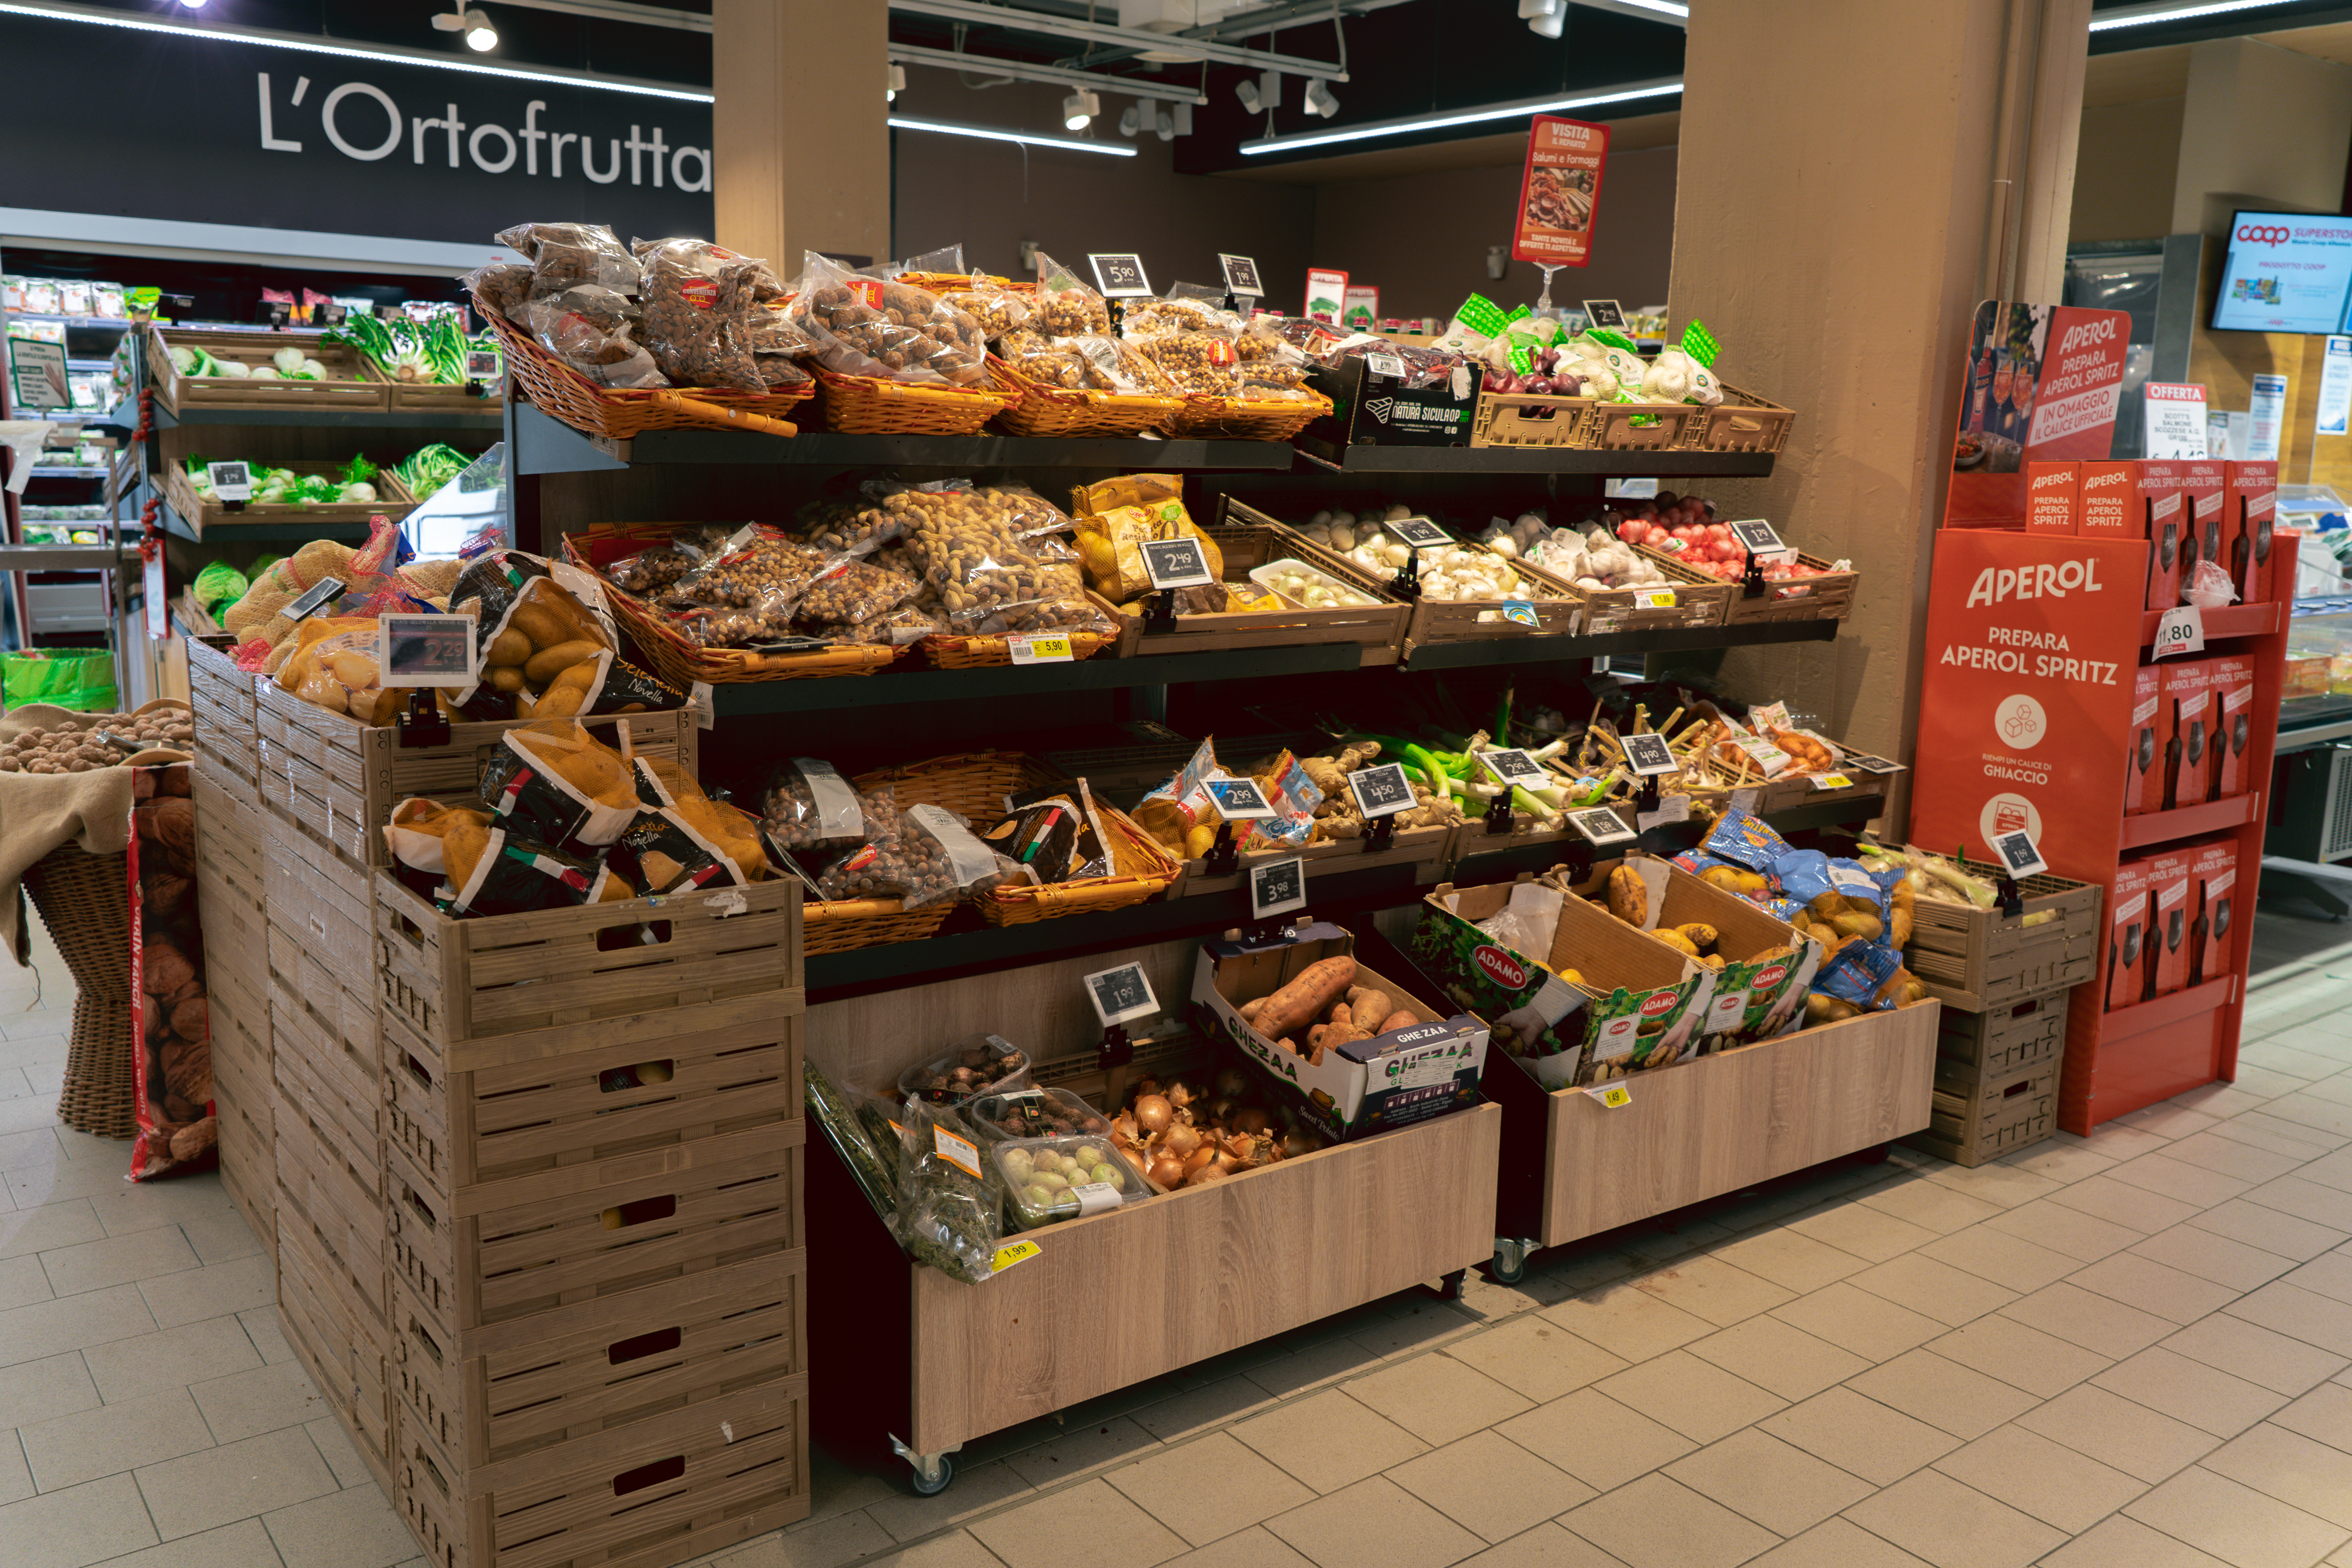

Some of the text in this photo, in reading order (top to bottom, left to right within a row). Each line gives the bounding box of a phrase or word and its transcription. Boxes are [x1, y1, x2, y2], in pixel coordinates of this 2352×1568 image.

[1552, 122, 1590, 141] VISITA
[1552, 138, 1586, 149] IL REPARTO
[1532, 151, 1557, 163] Salumi
[1566, 154, 1600, 168] Formaggi
[1531, 233, 1550, 243] TANTE
[1550, 235, 1572, 245] NOVITÀ
[2237, 225, 2290, 248] coop
[1519, 239, 1586, 255] OFFERTE TI ASPETTANO!
[683, 288, 716, 296] CONVENIENZA
[2059, 316, 2117, 355] APEROL
[2062, 349, 2106, 375] PREPARA
[2043, 362, 2120, 398] APEROL SPRITZ
[2150, 385, 2202, 401] OFFERTA
[1392, 405, 1421, 420] NATURA
[2043, 389, 2110, 423] IN OMAGGIO
[2034, 405, 2113, 441] IL CALICE UFFICIALE
[2149, 467, 2171, 476] PREPARA
[2191, 466, 2214, 476] PREPARA
[2244, 467, 2266, 476] PREPARA
[2032, 471, 2074, 490] APEROL
[2084, 472, 2128, 490] APEROL
[2137, 477, 2181, 489] APEROL SPRITZ
[2181, 476, 2224, 487] APEROL SPRITZ
[2233, 477, 2276, 487] APEROL SPRITZ
[2034, 497, 2070, 505] PREPARA
[2087, 497, 2123, 506] PREPARA
[2034, 506, 2069, 514] APEROL
[2087, 506, 2123, 515] APEROL
[2033, 515, 2069, 525] SPRITZ
[2086, 516, 2123, 526] SPRITZ
[1966, 557, 2102, 609] APEROL
[1989, 627, 2069, 652] PREPARA
[2159, 624, 2193, 644] 11,80
[1046, 641, 1063, 653] 5,90
[1940, 645, 2118, 686] APEROL SPRITZ
[2177, 668, 2200, 678] PREPARA
[2220, 662, 2243, 671] PREPARA
[2165, 676, 2209, 691] APEROL SPRITZ
[2210, 670, 2252, 684] APEROL SPRITZ
[628, 678, 663, 705] Novella
[2139, 681, 2157, 694] SPRITZ
[1982, 753, 2004, 764] RIEMPI
[2017, 759, 2042, 770] CALICE
[1983, 764, 2048, 785] GHIACCIO
[622, 831, 662, 851] Novella
[2203, 848, 2226, 860] PREPARA
[2154, 858, 2177, 870] PREPARA
[2192, 855, 2236, 874] APEROL SPRITZ
[2147, 864, 2187, 882] PEROL SPRITZ
[2126, 878, 2146, 891] SPRITZ
[1478, 950, 1522, 984] ADAMO
[132, 957, 141, 1009] RANCH
[1753, 969, 1784, 985] ADAMO
[1642, 996, 1676, 1012] ADAMO
[1720, 999, 1739, 1008] ADAMO
[1611, 1023, 1630, 1033] ADAMO
[1228, 1016, 1298, 1083] GHEZAA
[136, 1068, 145, 1115] WALNUTS
[1607, 1092, 1619, 1104] 1,49
[1420, 1099, 1439, 1107] Industrial
[1298, 1105, 1339, 1141] Sweet Potato
[1004, 1245, 1027, 1258] 1,99
